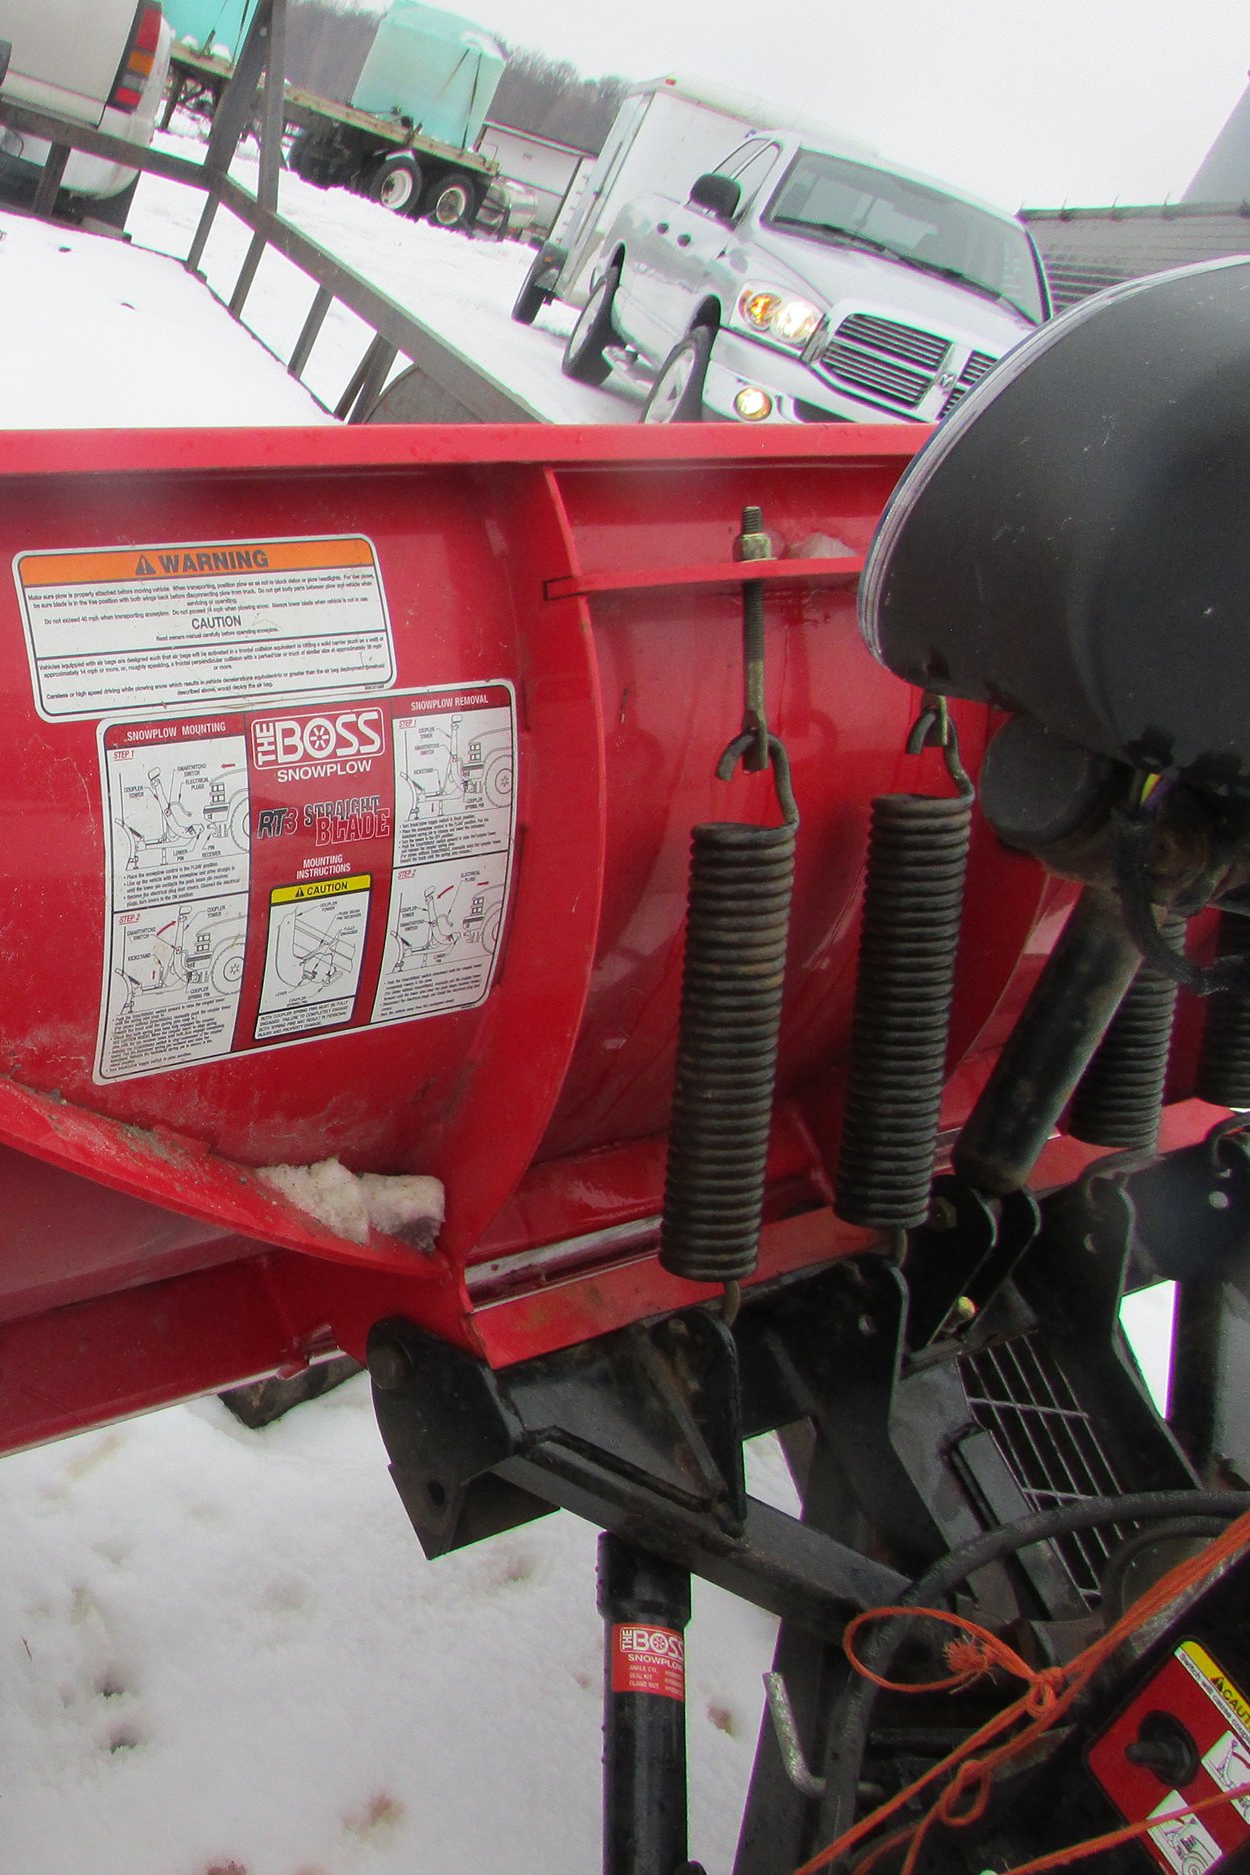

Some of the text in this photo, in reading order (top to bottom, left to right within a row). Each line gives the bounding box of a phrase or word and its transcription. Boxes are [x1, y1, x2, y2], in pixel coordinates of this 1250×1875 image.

[158, 550, 269, 573] WARNING
[192, 615, 241, 629] CAUTION
[411, 695, 488, 711] SNOWPLOW REMOVAL
[127, 722, 226, 741] SNOWPLOW MOUNTING
[256, 712, 380, 766] THE BOSS
[113, 750, 130, 760] STEP
[277, 760, 371, 783] SNOWPLOW
[257, 795, 380, 839] RT3 STRAIGHT
[316, 808, 390, 846] BLADE
[303, 854, 343, 868] MOUNTING
[296, 863, 350, 879] INSTRUCTIONS
[307, 882, 348, 895] CAUTION
[119, 915, 136, 924] STEP
[622, 1629, 632, 1650] THE
[1179, 1653, 1201, 1679] Switch
[1213, 1695, 1231, 1718] cause
